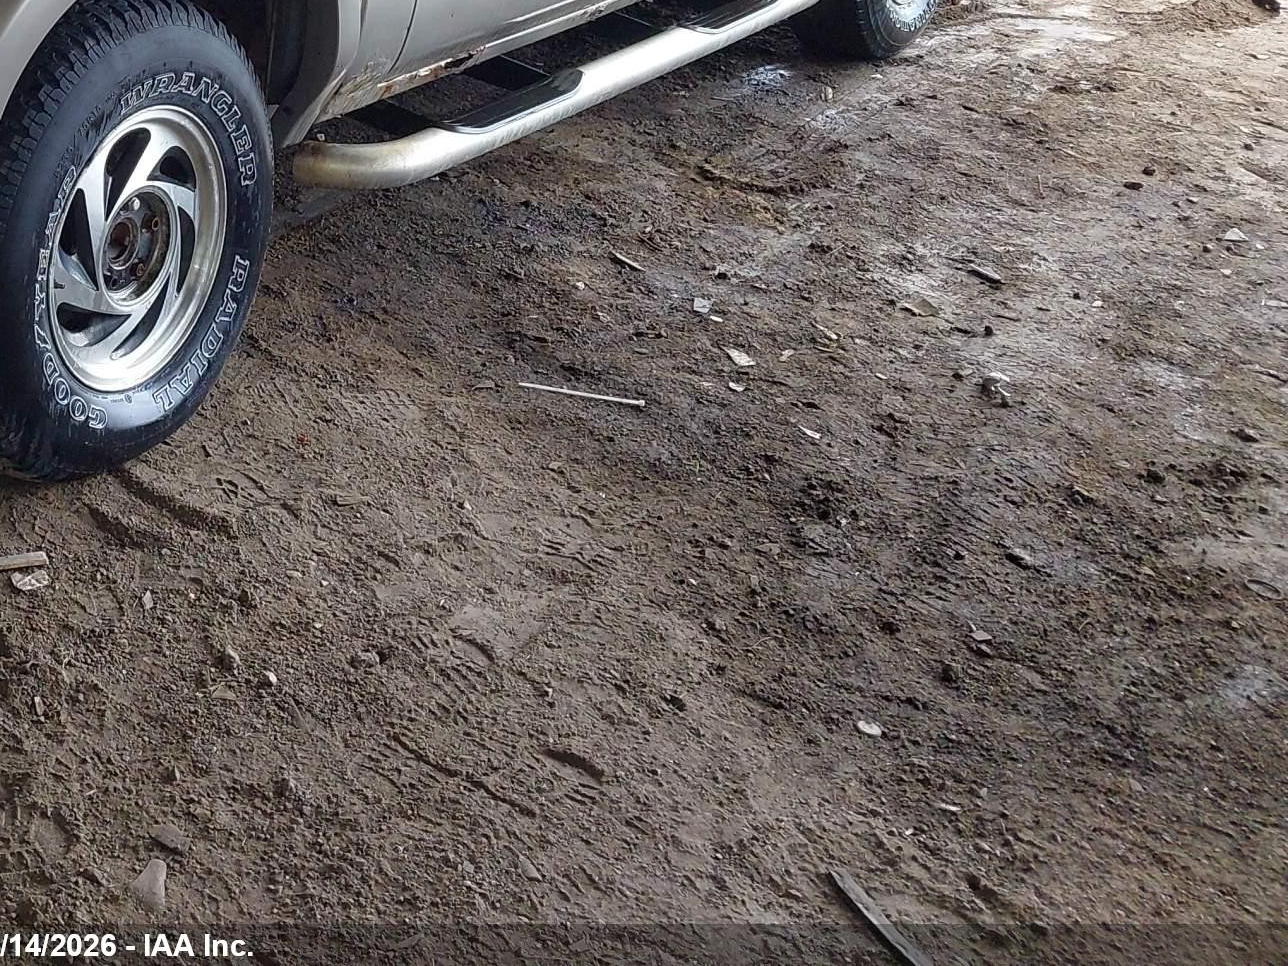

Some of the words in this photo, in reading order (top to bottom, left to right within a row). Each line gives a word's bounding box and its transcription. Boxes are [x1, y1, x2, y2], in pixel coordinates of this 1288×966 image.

[120, 71, 258, 187] WRANGLER
[34, 165, 108, 430] GOODYEAR
[153, 254, 250, 411] RADIAL
